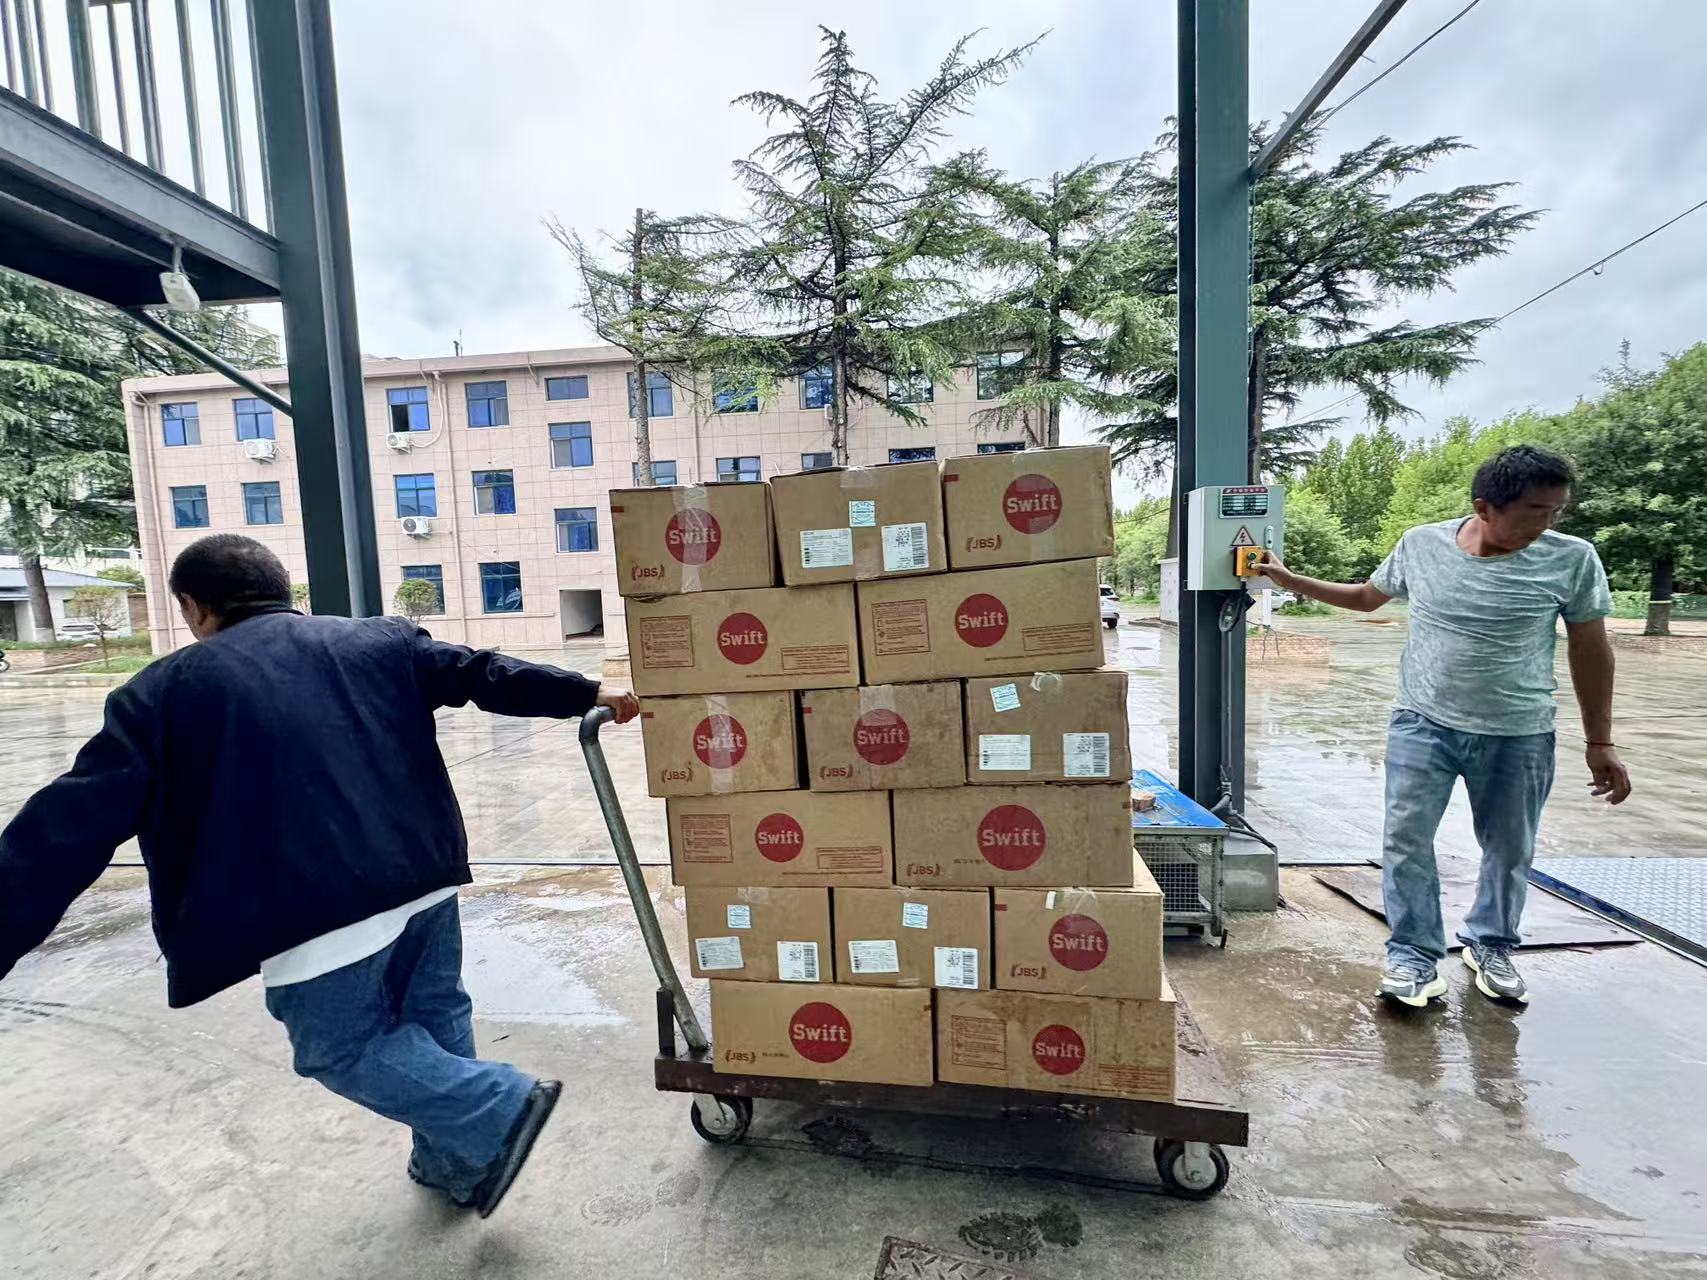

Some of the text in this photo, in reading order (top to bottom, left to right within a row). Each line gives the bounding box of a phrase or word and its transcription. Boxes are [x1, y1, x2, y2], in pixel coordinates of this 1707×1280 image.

[1007, 494, 1058, 513] Swift
[669, 527, 718, 545] Swift
[957, 611, 1005, 629] Swift
[720, 630, 766, 647] Swift
[697, 733, 743, 751] Swift
[857, 728, 906, 745] Swift
[758, 830, 801, 845] Swift
[982, 828, 1041, 847] Swift
[1052, 933, 1105, 952] Swift
[793, 1023, 848, 1042] Swift
[1035, 1042, 1081, 1059] Swift
